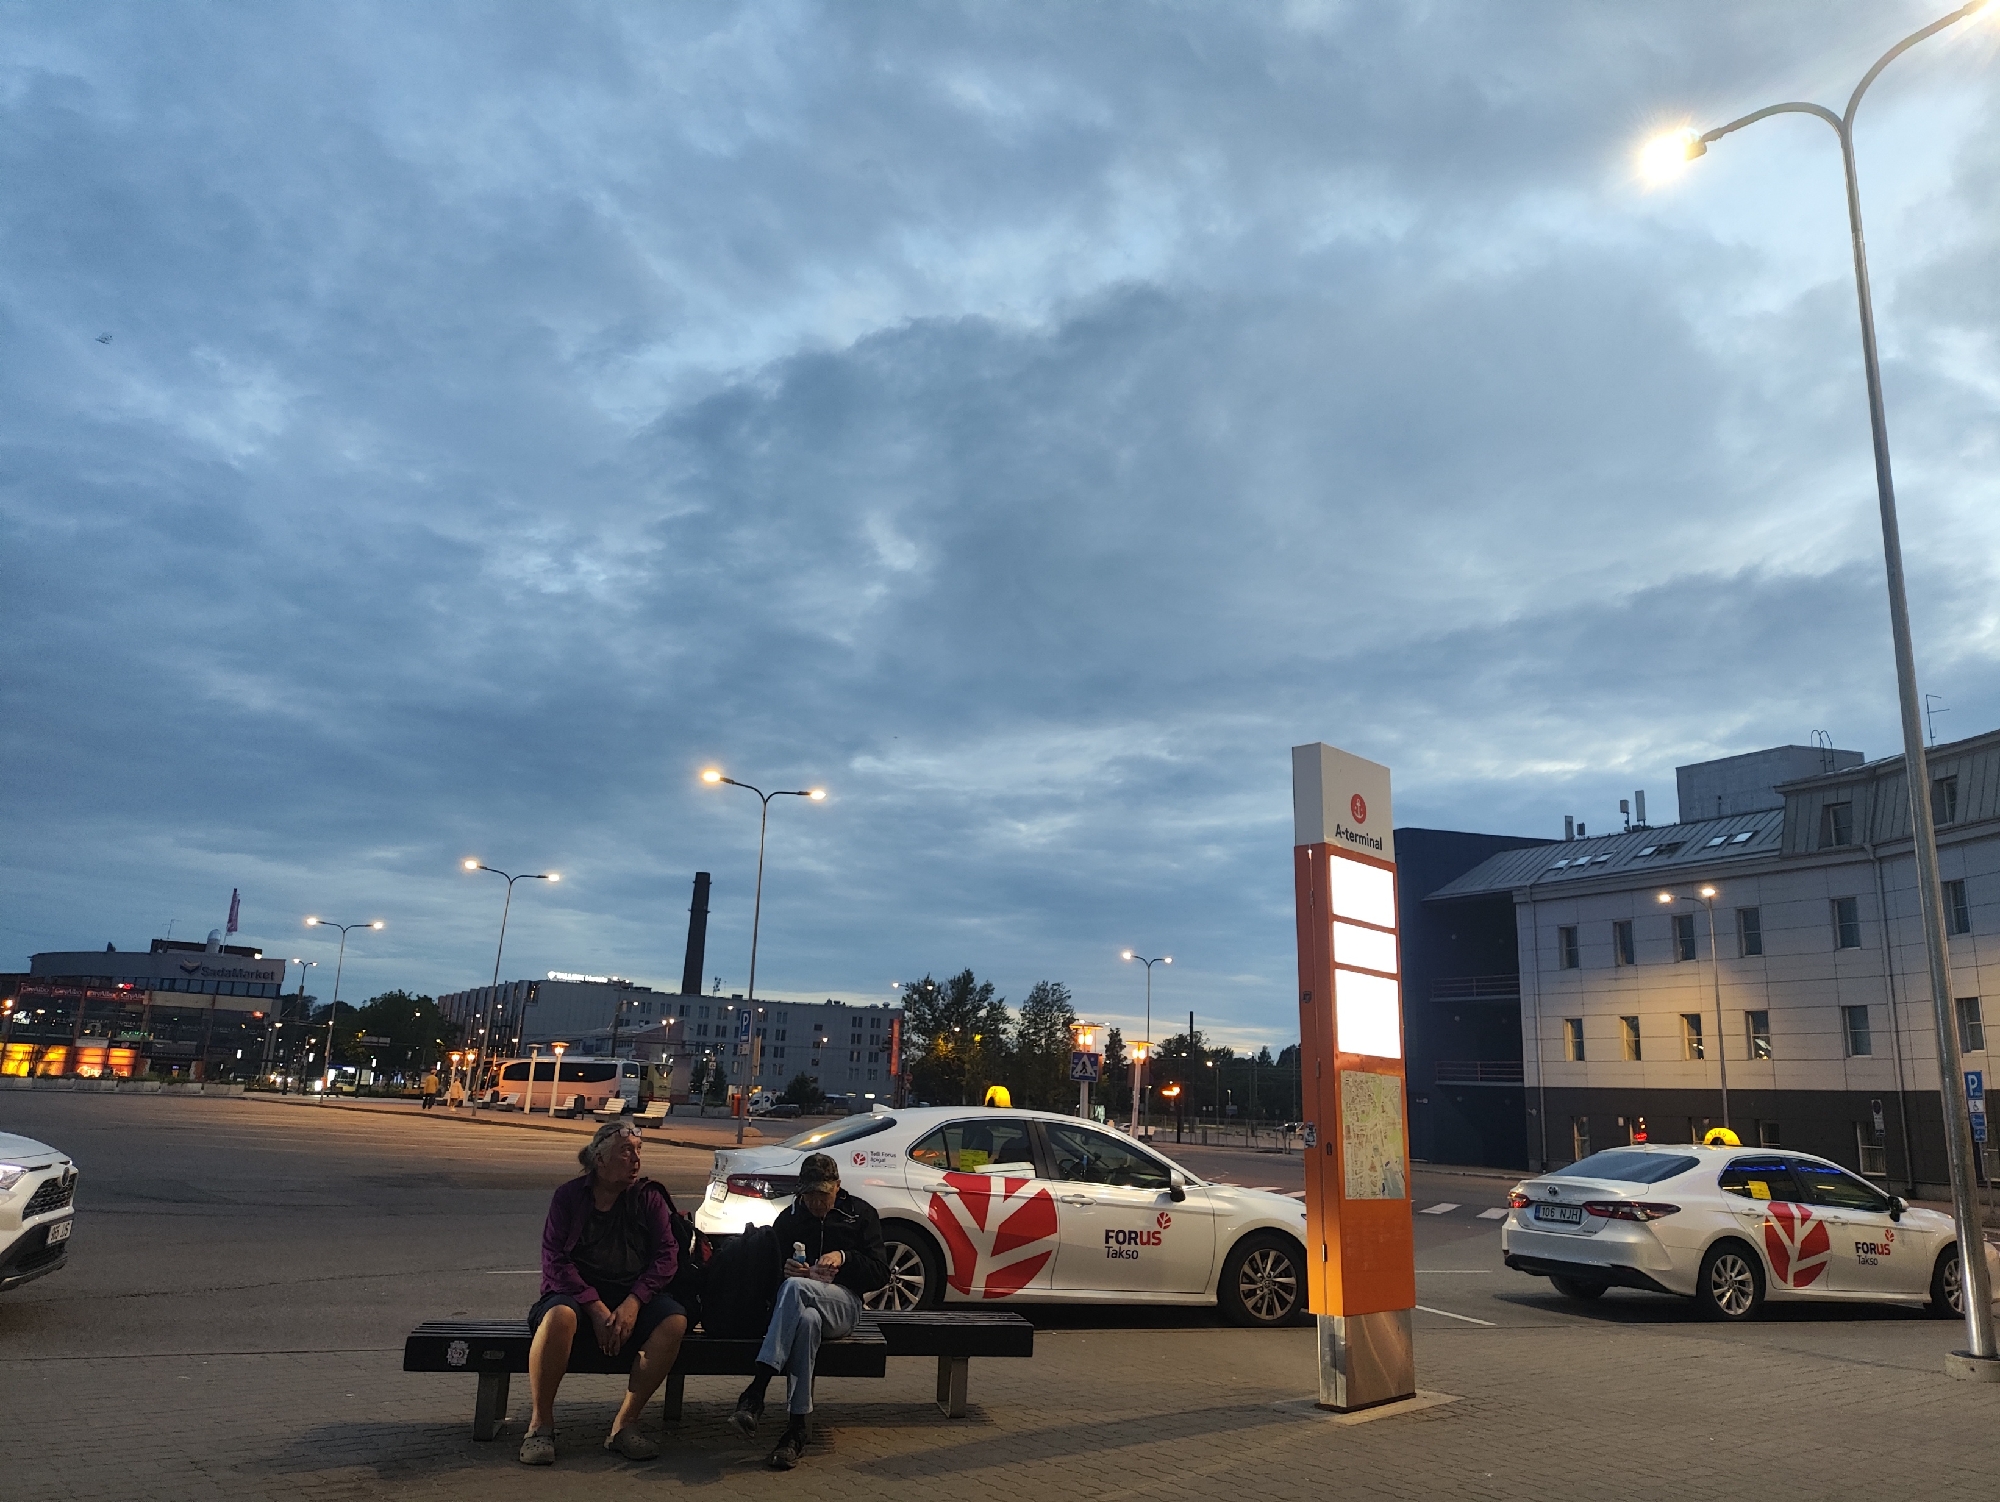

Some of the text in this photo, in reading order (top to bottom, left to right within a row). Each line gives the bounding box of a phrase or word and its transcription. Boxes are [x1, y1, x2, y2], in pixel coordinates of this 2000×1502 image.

[1335, 824, 1382, 850] A-terminal
[201, 966, 275, 981] SadaMarket
[1542, 1207, 1578, 1220] 106 NJH
[1105, 1229, 1162, 1246] FORUS
[1105, 1246, 1139, 1260] Takso
[1855, 1242, 1891, 1256] FORUS
[1857, 1255, 1879, 1266] Takso
